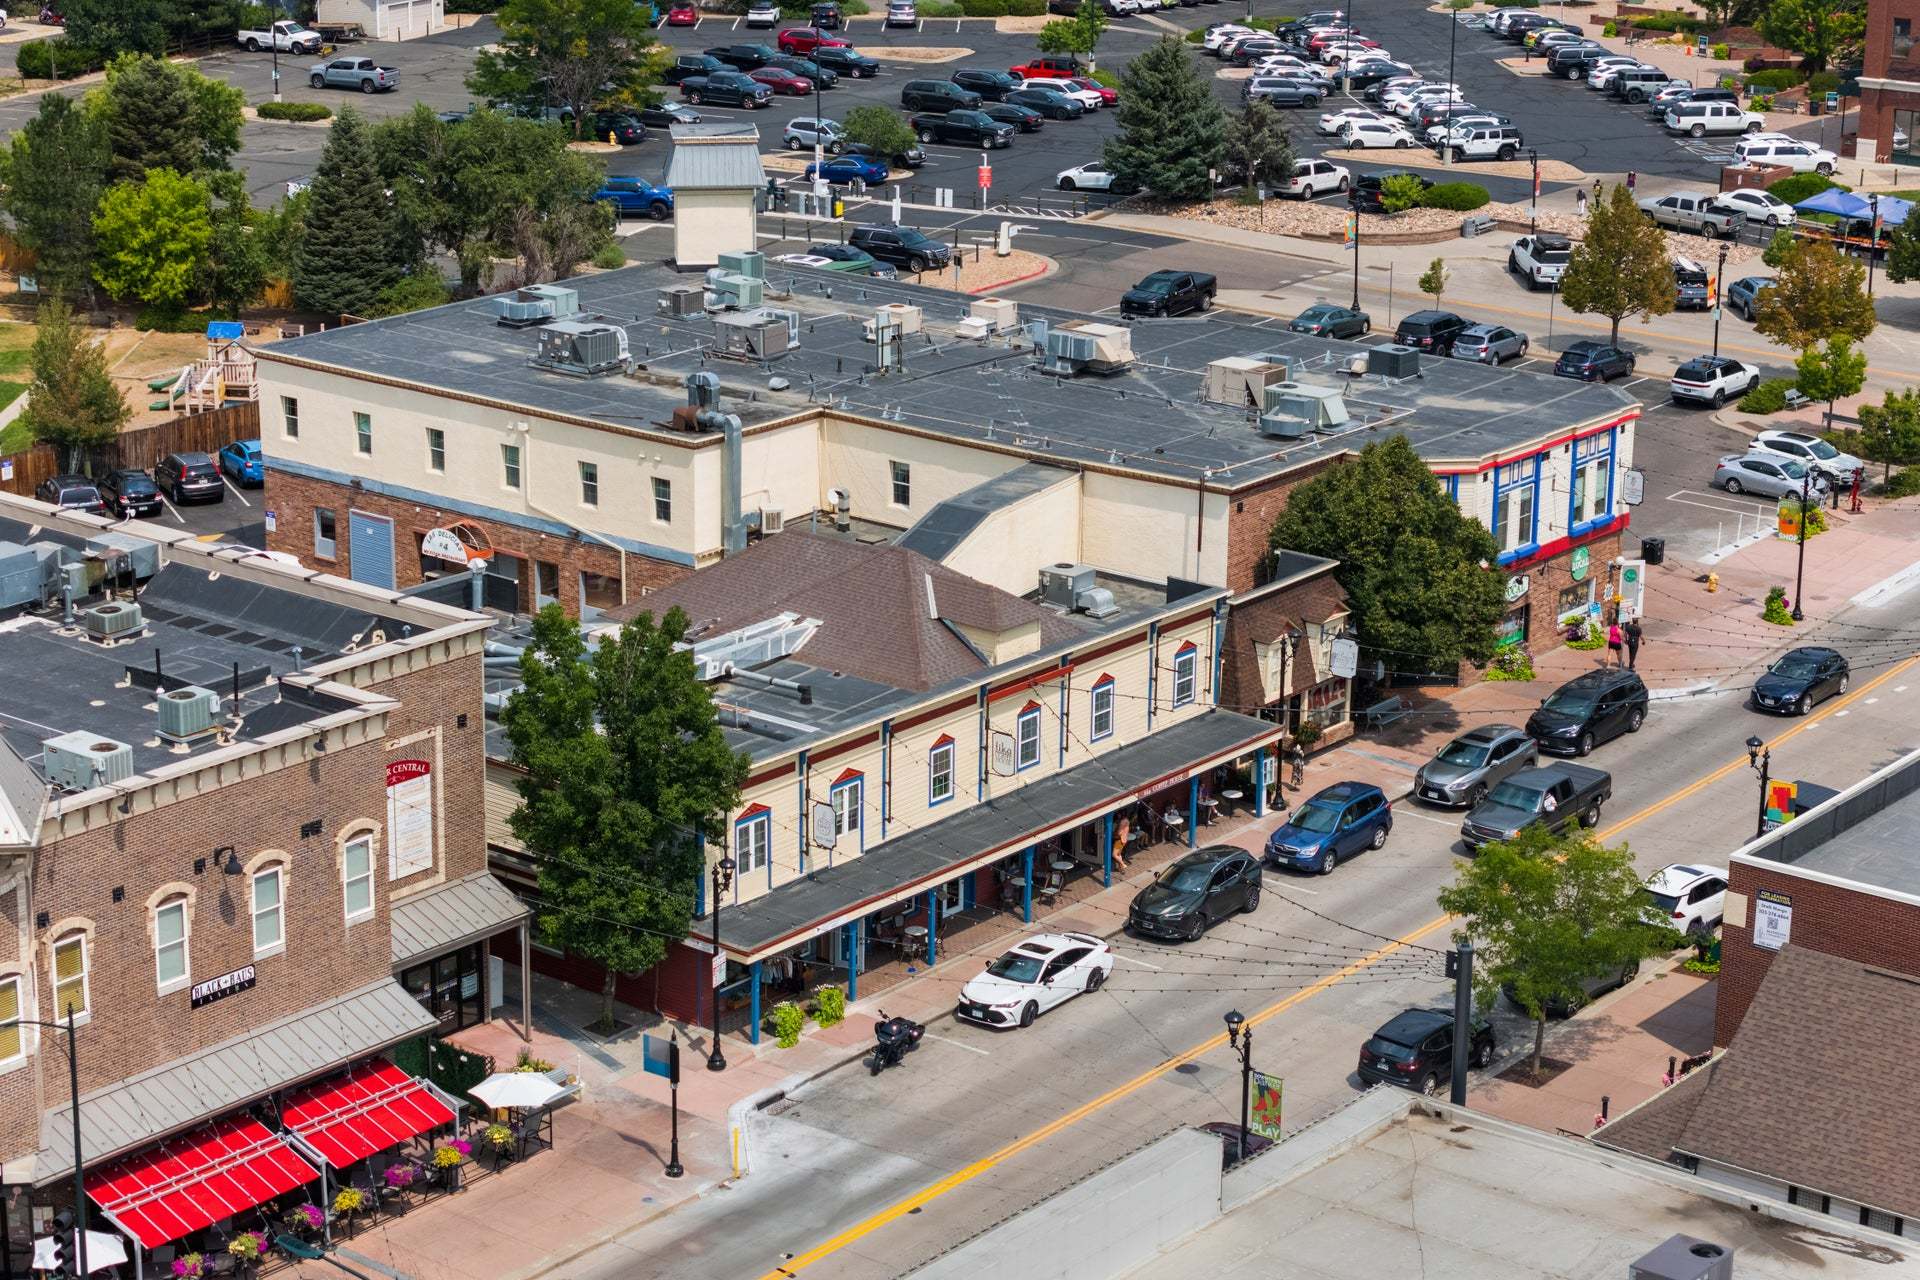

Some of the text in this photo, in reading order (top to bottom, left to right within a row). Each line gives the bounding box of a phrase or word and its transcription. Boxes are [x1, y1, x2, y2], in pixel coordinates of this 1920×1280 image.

[392, 763, 426, 774] CENTRAL
[194, 979, 222, 998] BLACK
[1252, 1121, 1280, 1139] PLAY
